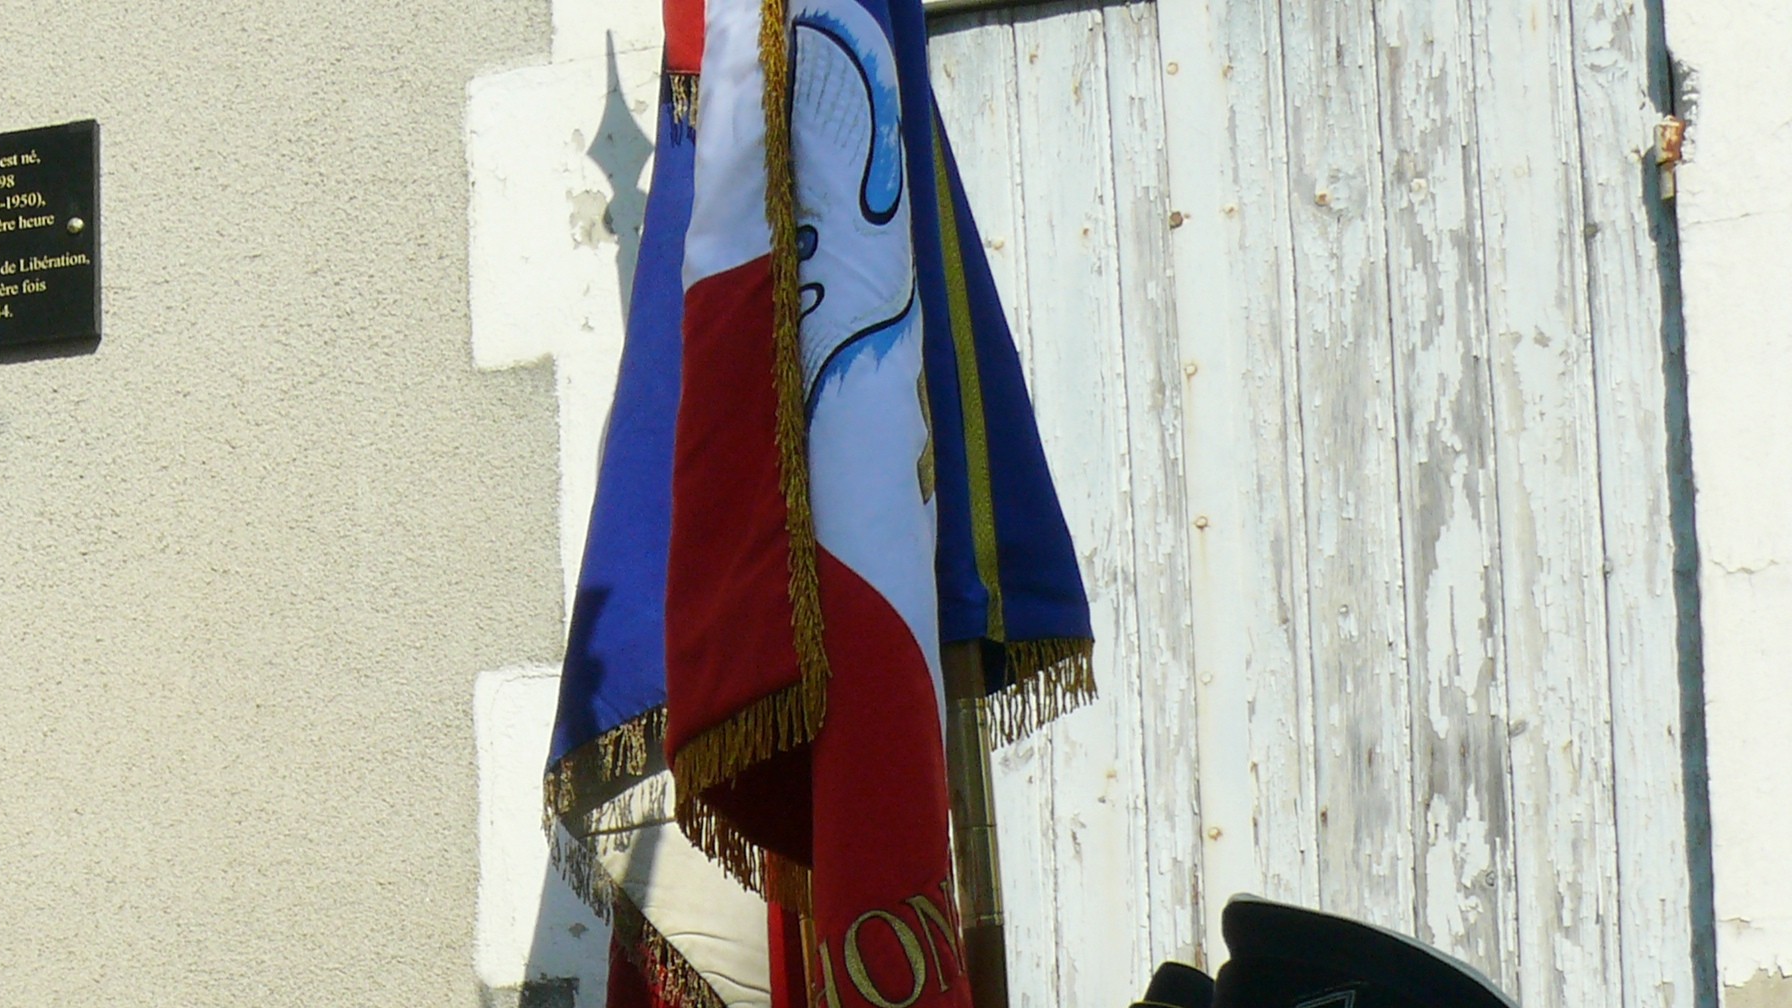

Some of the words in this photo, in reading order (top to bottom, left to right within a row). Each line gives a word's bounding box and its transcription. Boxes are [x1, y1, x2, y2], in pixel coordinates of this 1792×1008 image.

[0, 154, 18, 168] est
[20, 149, 41, 165] né,
[18, 214, 55, 229] heure
[0, 260, 16, 275] de
[19, 251, 90, 272] Libération,
[22, 278, 47, 294] fois
